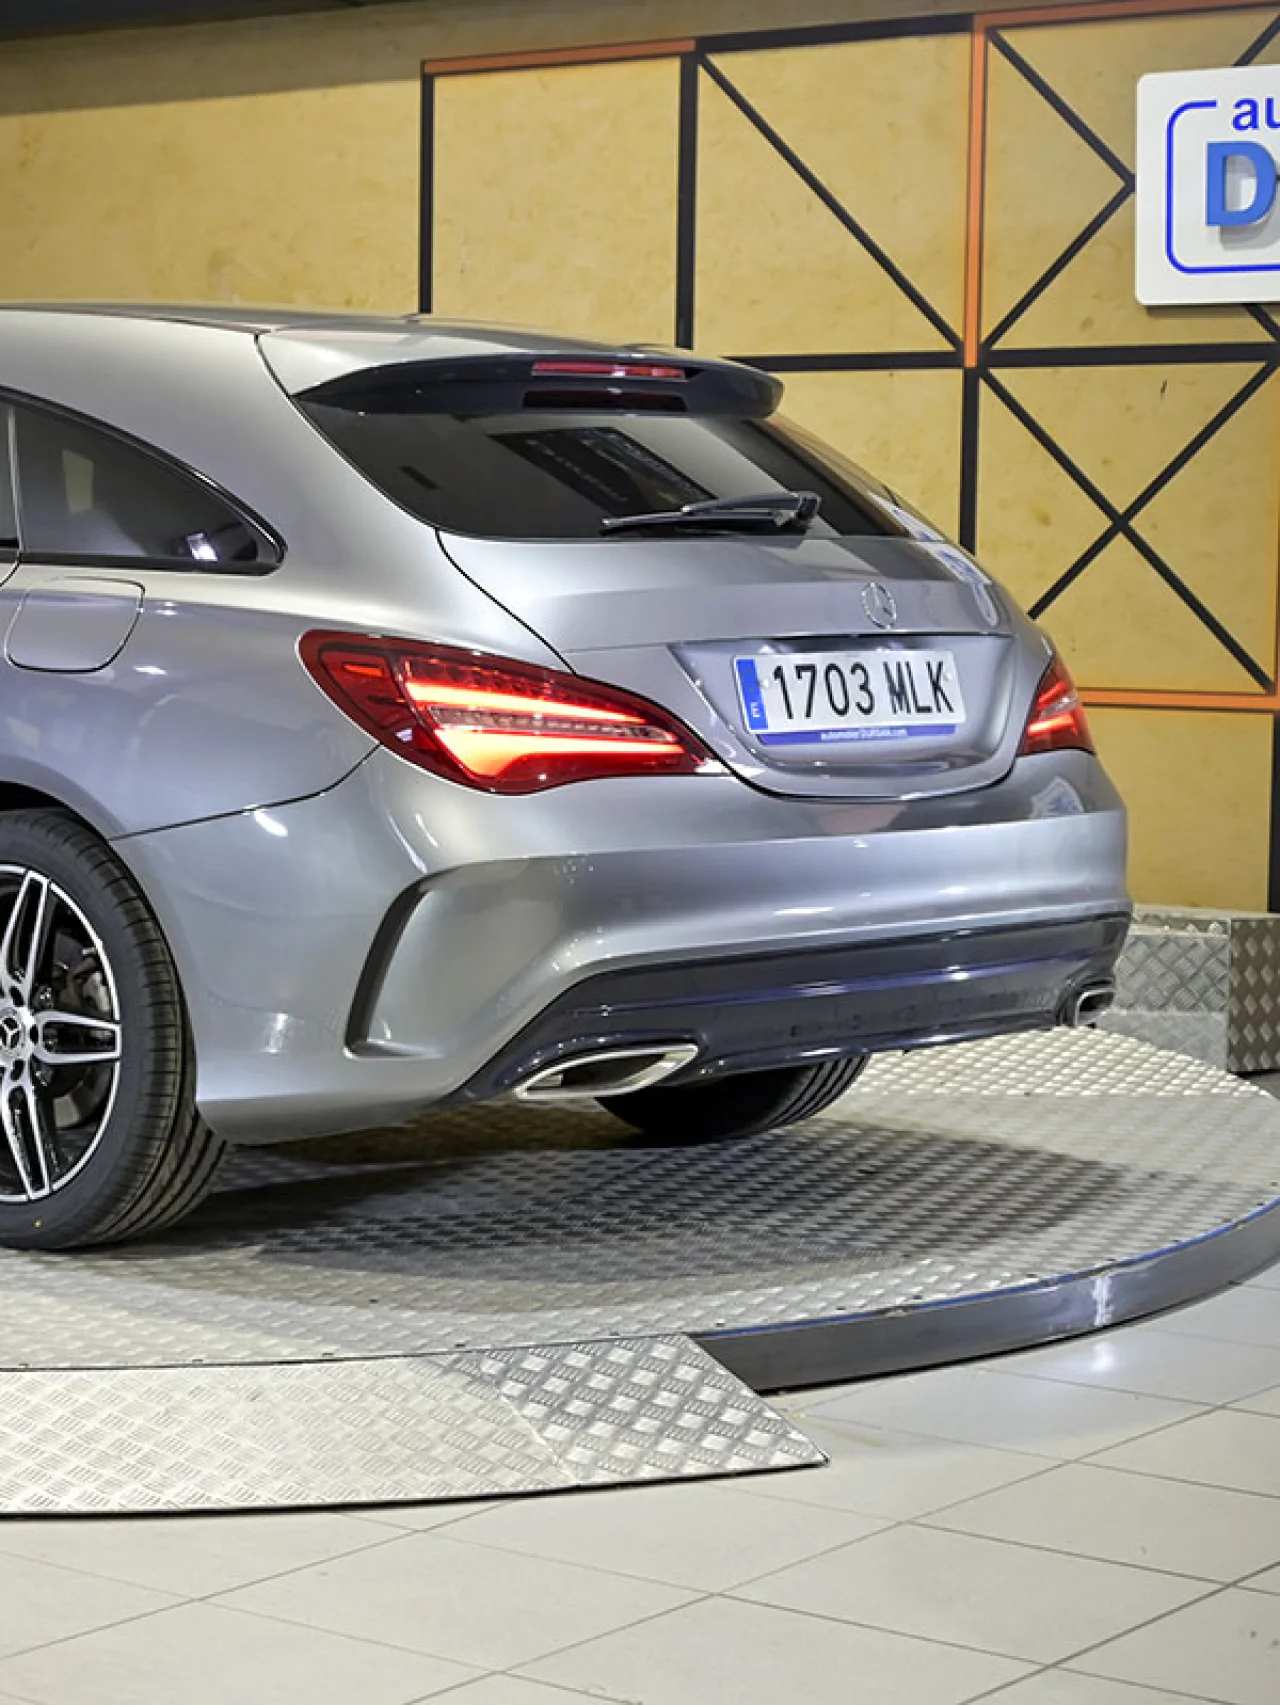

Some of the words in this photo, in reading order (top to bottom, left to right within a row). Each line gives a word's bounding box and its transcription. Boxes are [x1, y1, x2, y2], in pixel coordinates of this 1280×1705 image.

[773, 662, 875, 719] 1703
[883, 660, 954, 715] MLK
[750, 702, 761, 718] E
